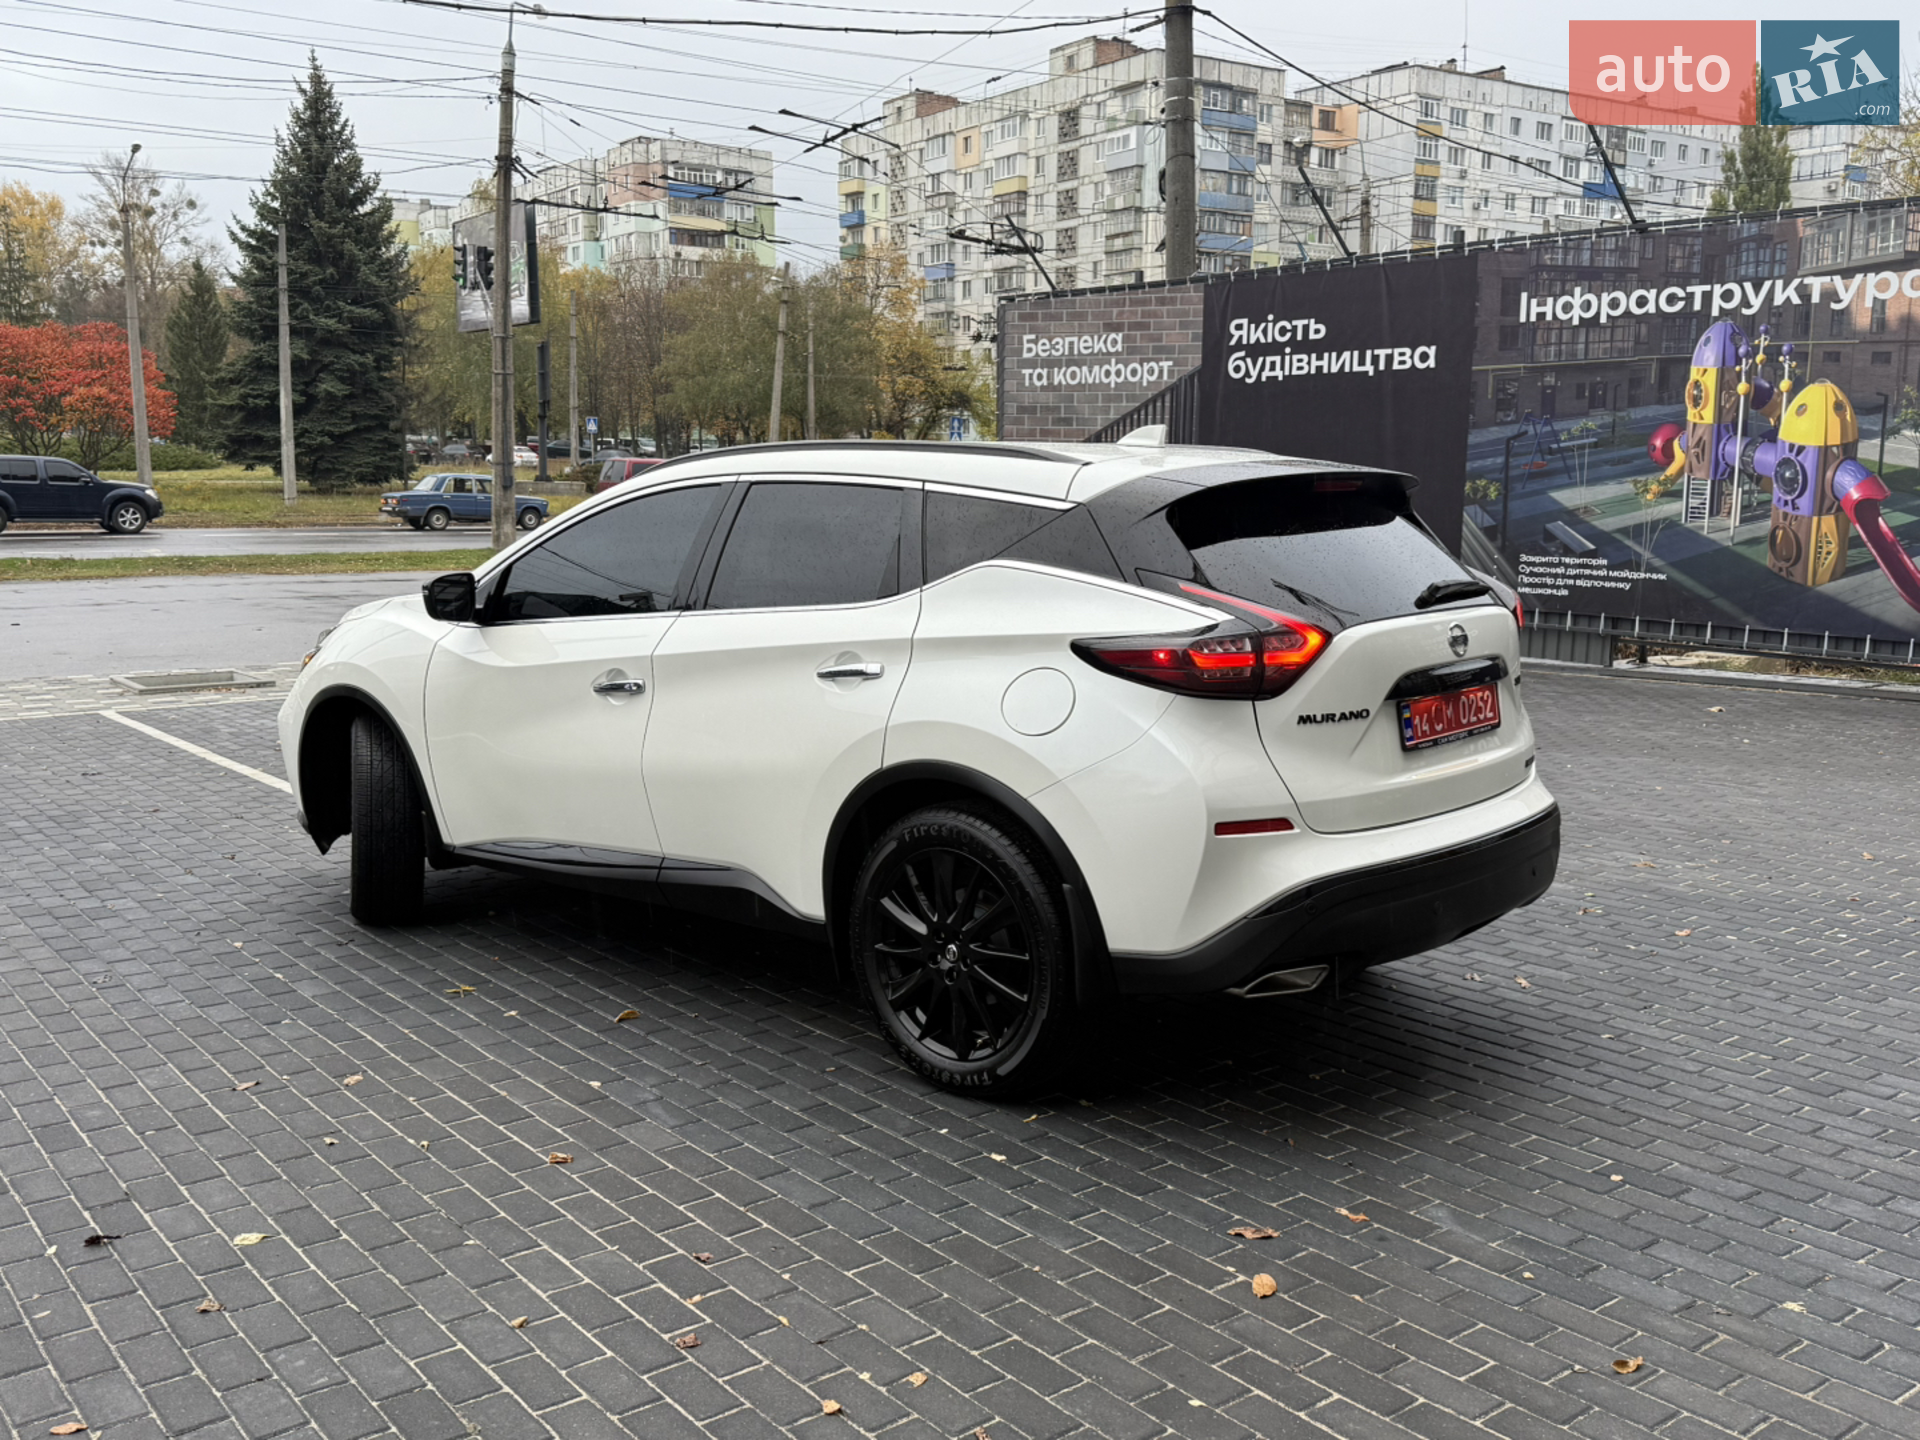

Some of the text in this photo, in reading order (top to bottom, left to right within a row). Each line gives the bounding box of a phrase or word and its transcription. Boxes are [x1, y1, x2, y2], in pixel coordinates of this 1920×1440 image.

[1228, 314, 1327, 346] Якість
[1022, 333, 1123, 358] Безпека
[1022, 358, 1174, 388] та комфорт
[1227, 345, 1437, 384] будівництва
[1518, 564, 1668, 581] Сучасний дитячий майданчик
[1519, 553, 1608, 567] Закрита територія
[1517, 586, 1569, 597] мешканців
[1518, 574, 1632, 591] Простір для відпочинку
[1297, 708, 1370, 725] MURANO
[1414, 713, 1430, 737] 14
[1460, 690, 1494, 725] 0252
[902, 823, 994, 859] Firesto
